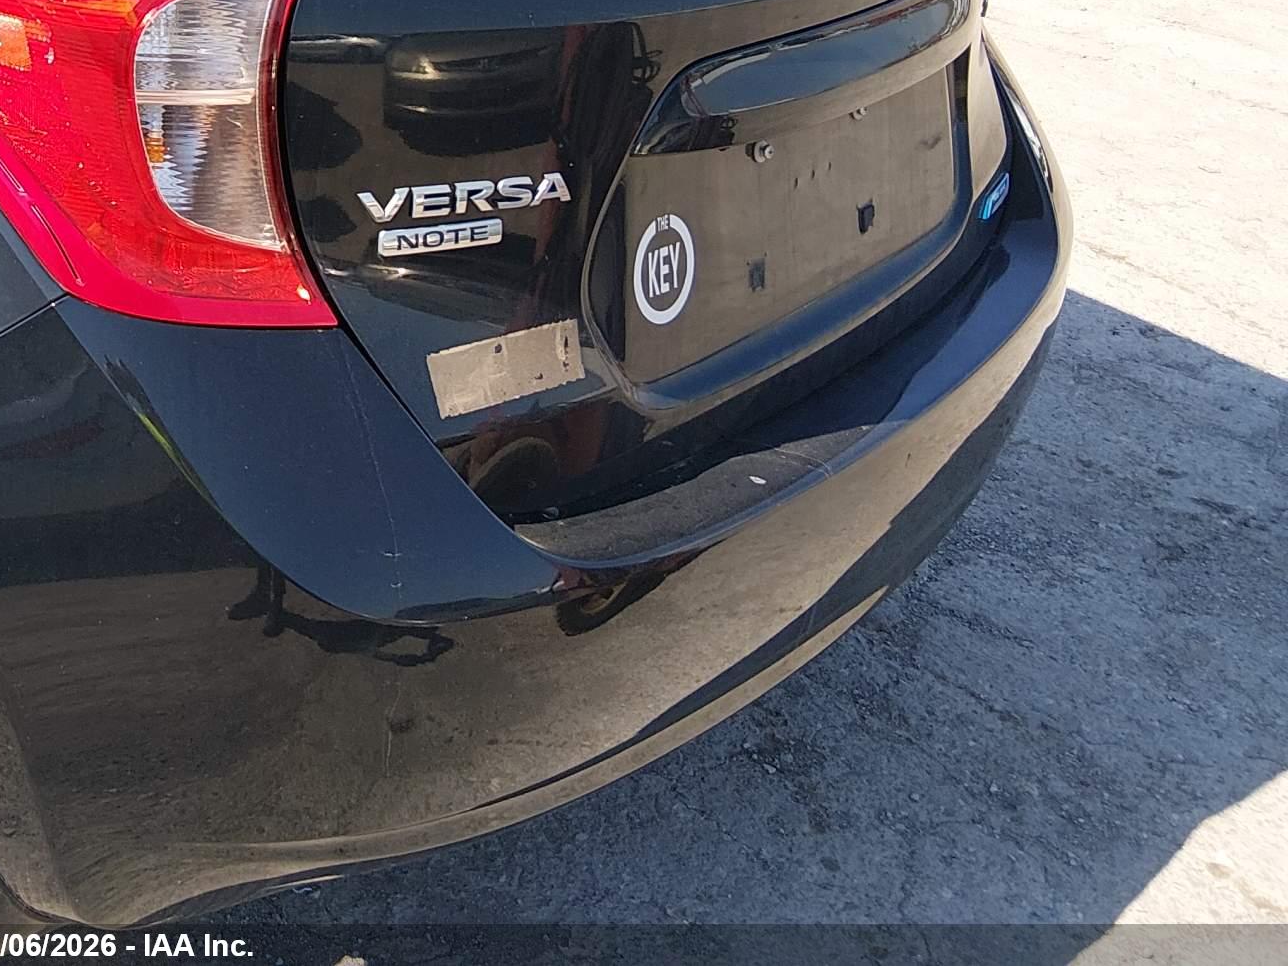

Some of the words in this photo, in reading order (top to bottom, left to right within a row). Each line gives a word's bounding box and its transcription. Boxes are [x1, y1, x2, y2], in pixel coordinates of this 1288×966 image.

[357, 172, 572, 223] VERSA
[396, 224, 489, 251] NOTE
[657, 215, 669, 232] THE
[648, 241, 680, 298] KEY
